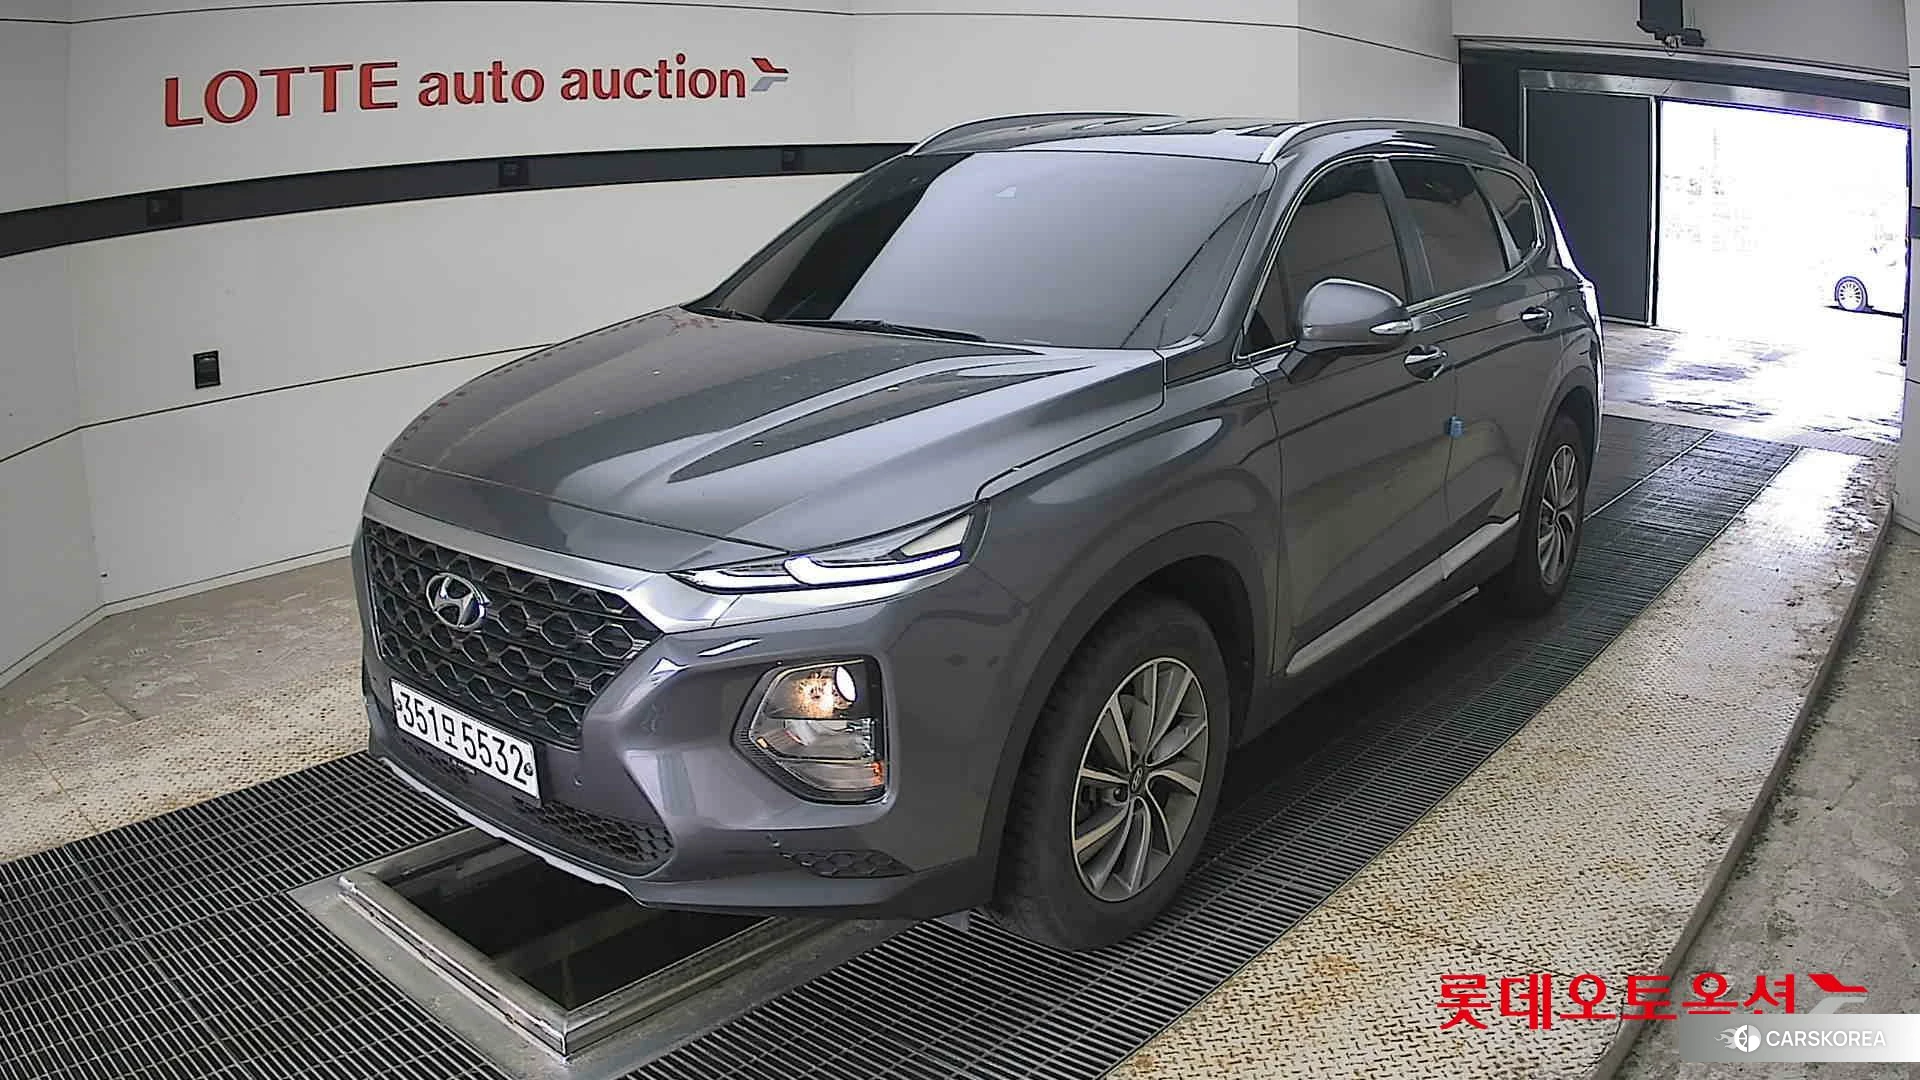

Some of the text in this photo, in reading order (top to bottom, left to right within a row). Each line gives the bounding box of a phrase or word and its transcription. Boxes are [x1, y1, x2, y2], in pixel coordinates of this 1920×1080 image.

[165, 53, 746, 127] LOTTE auto auction
